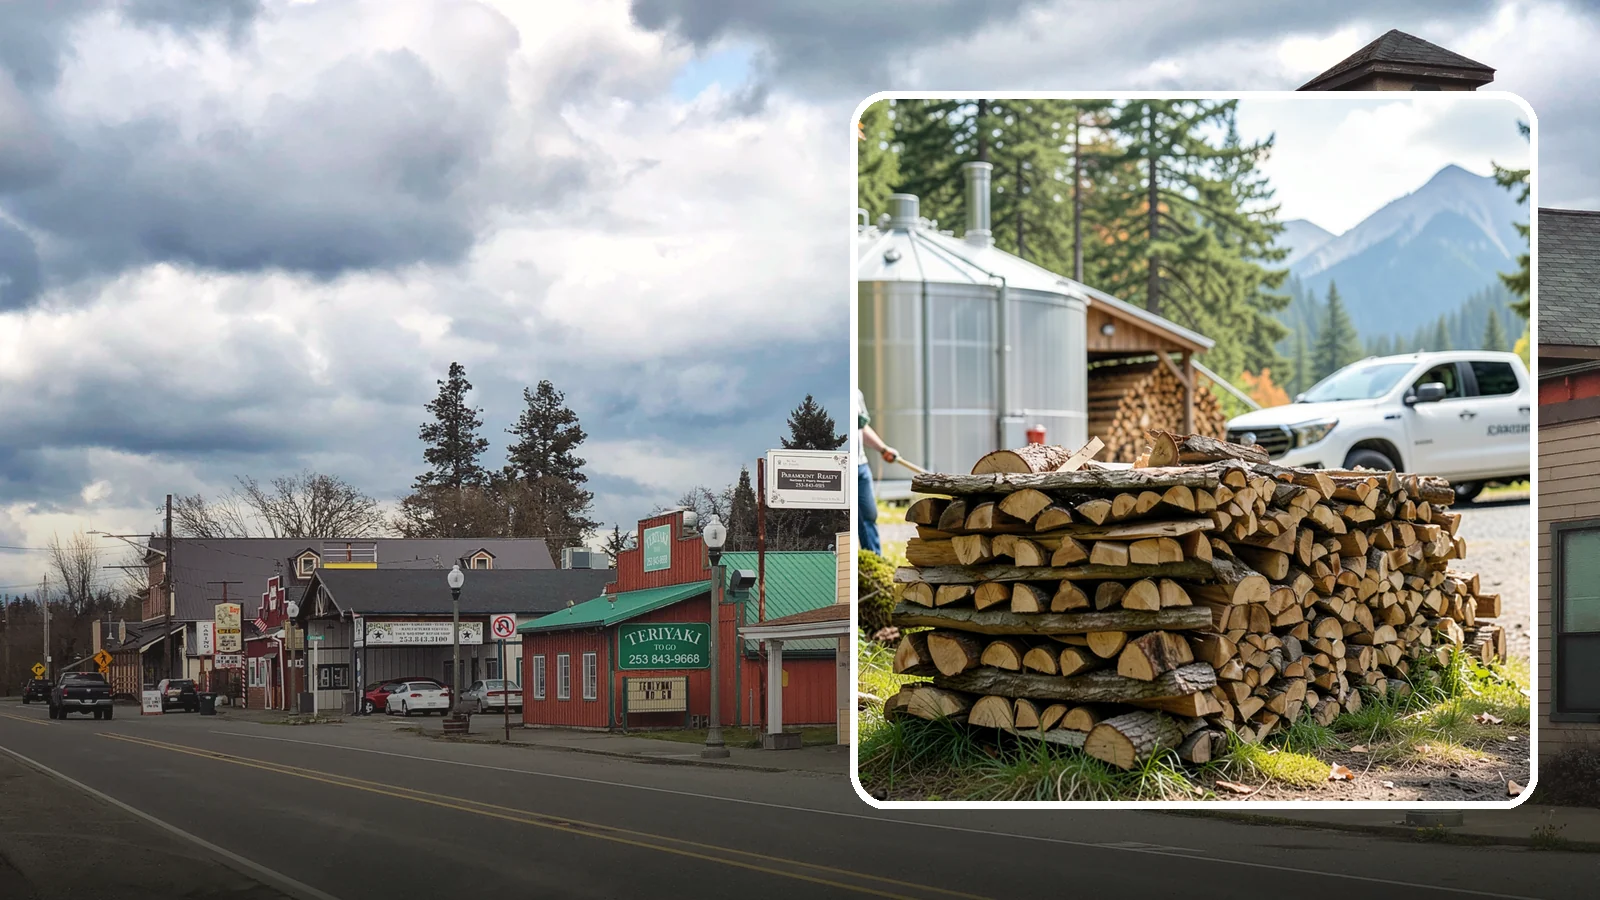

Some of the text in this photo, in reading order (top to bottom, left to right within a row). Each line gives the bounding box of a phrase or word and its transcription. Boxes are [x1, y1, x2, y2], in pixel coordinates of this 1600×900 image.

[781, 471, 839, 480] PARAMOUNT REALTY
[624, 627, 702, 646] TERIYAKI
[629, 653, 700, 665] 253 843-9668
